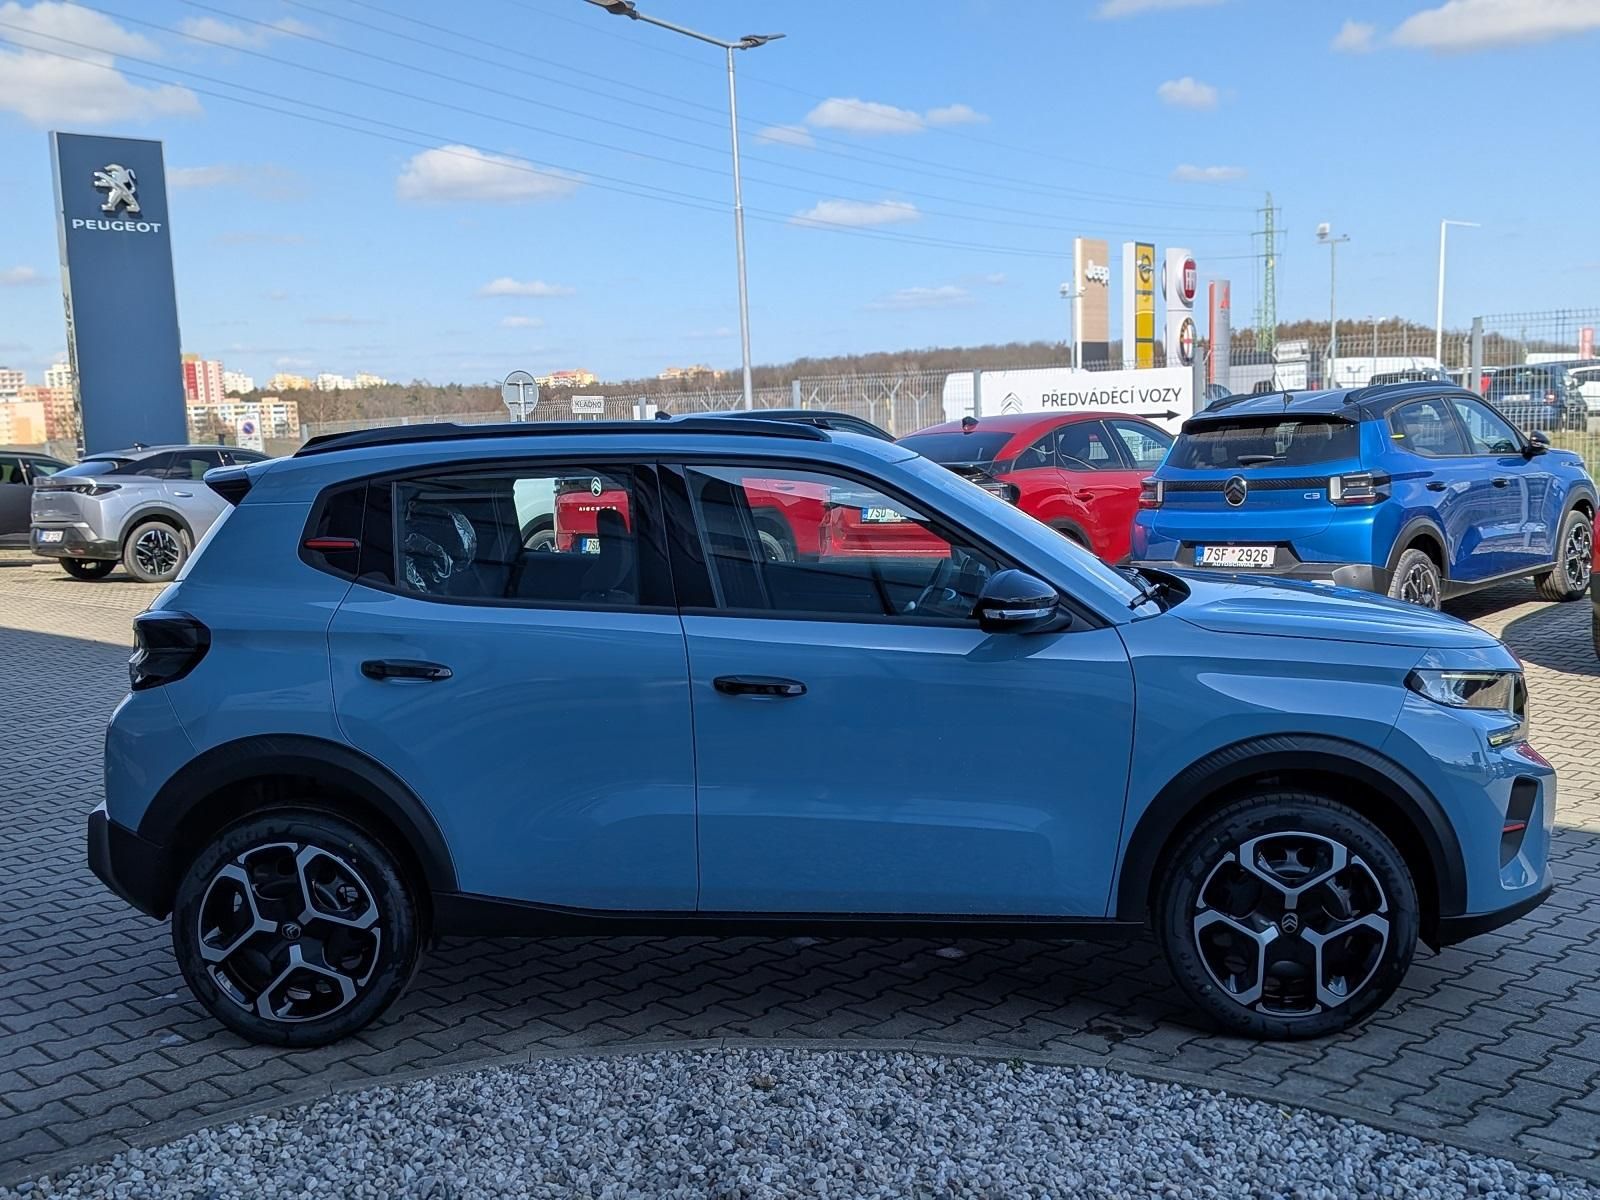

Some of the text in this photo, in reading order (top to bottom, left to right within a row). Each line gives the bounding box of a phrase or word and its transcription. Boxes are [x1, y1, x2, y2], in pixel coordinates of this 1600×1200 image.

[72, 218, 161, 233] PEUGEOT
[1085, 259, 1110, 285] Jeep
[1042, 385, 1182, 407] PŘEDVÁDĚCÍ VOZY
[1303, 492, 1321, 500] C3
[1206, 547, 1269, 563] 7SF 2926
